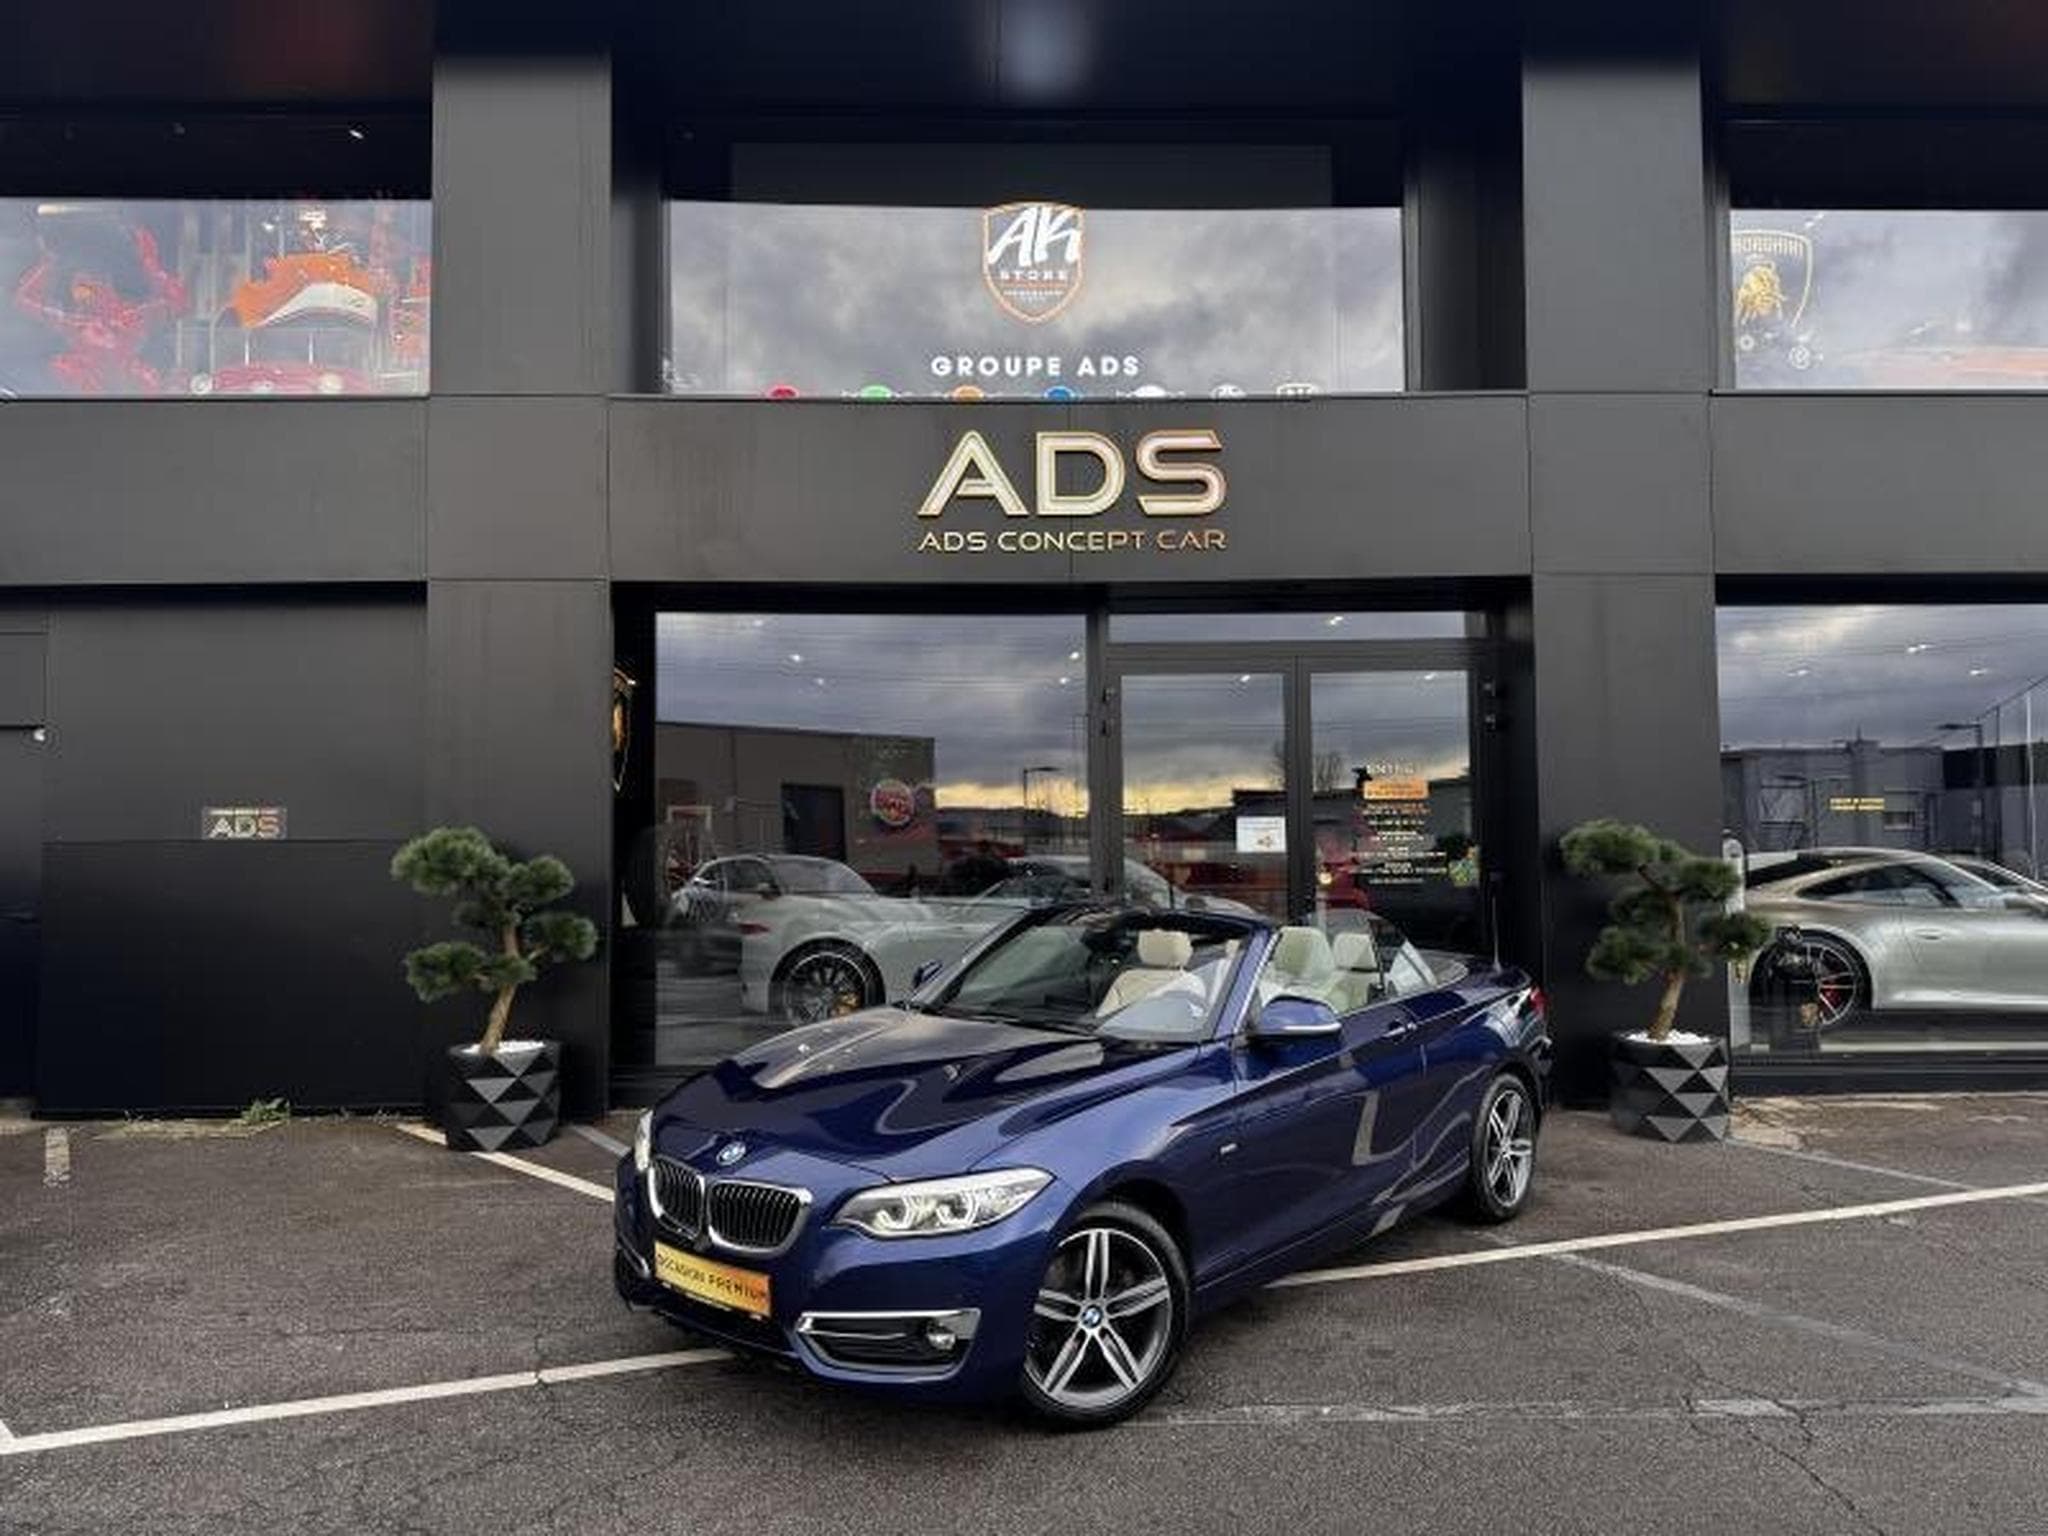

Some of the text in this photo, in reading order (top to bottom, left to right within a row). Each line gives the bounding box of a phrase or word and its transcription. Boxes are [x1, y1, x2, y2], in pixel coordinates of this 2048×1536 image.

[931, 355, 1139, 377] GROUPE ADS
[917, 429, 1227, 518] ADS
[917, 529, 1227, 553] ADS CONCEPT CAR
[208, 815, 280, 838] ADS
